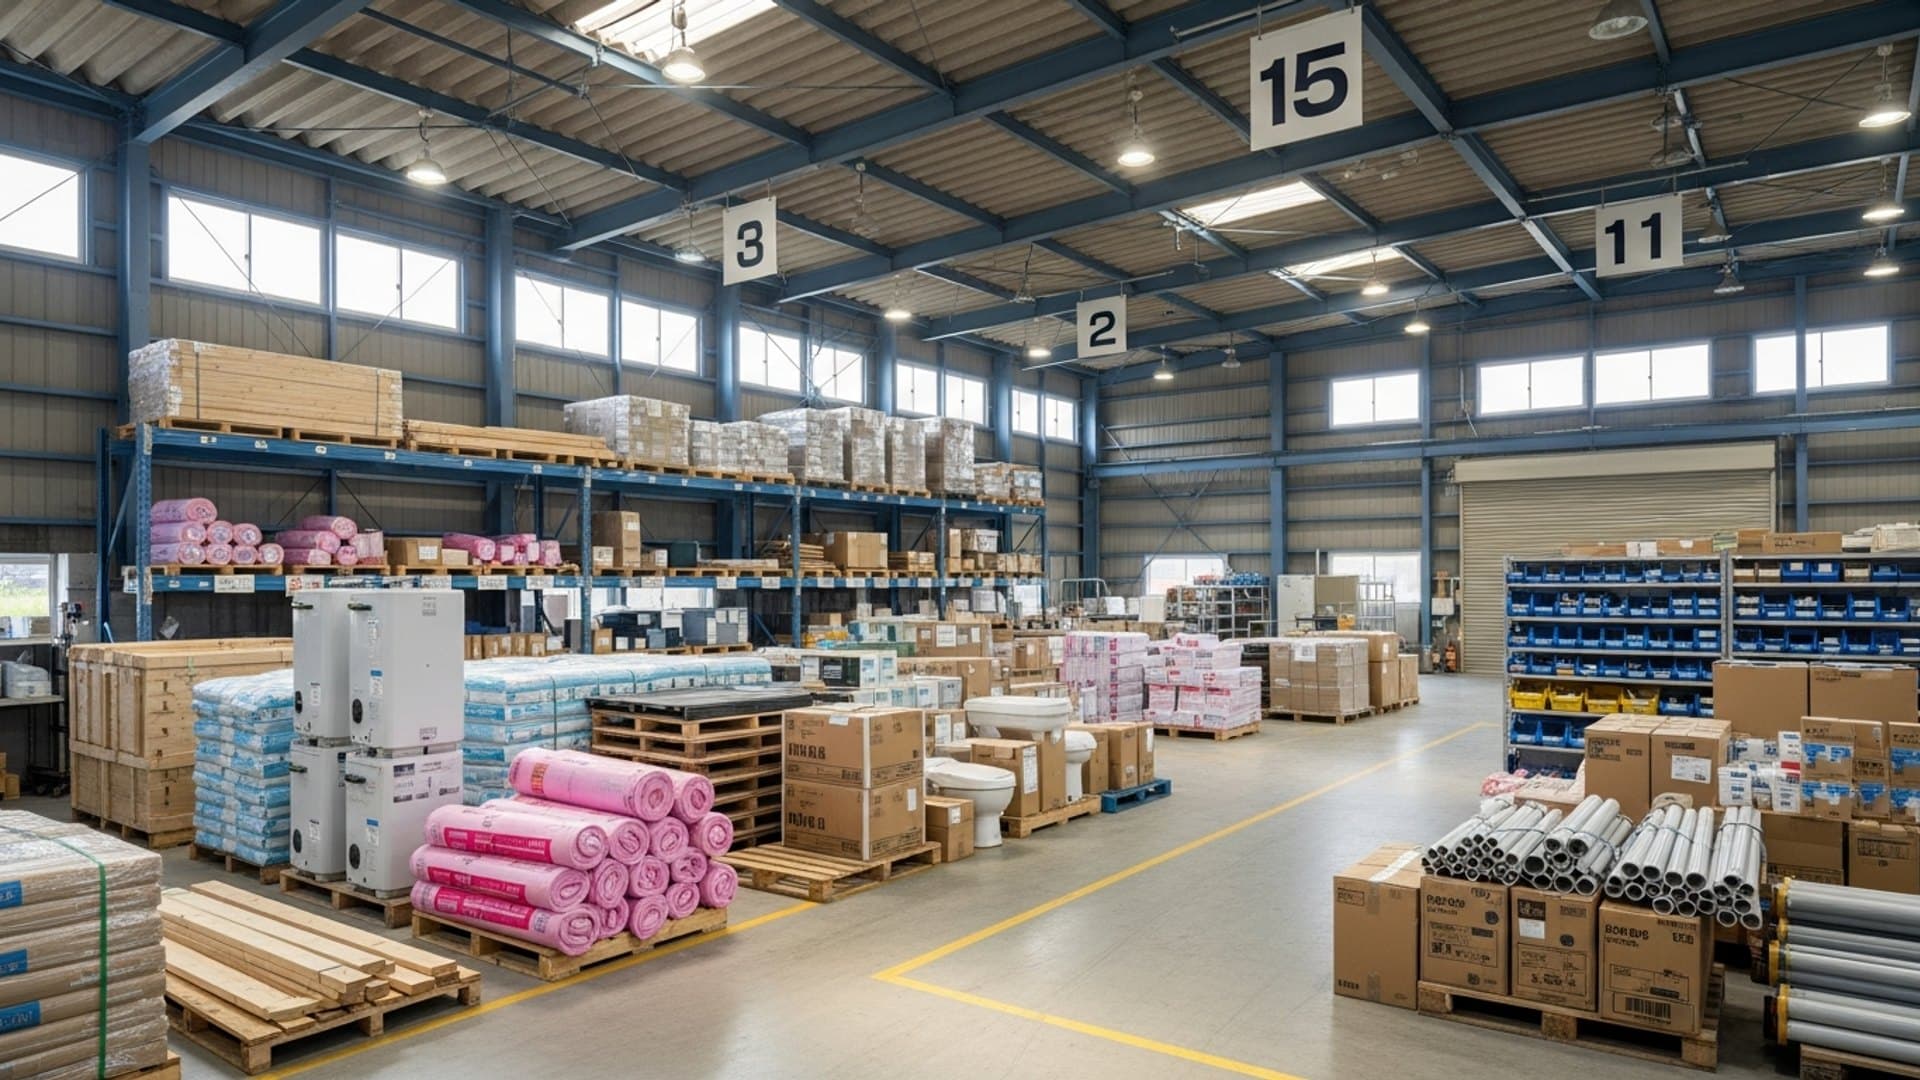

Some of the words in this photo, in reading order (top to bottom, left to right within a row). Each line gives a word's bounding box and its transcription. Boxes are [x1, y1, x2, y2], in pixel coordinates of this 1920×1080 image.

[1260, 41, 1348, 126] 15
[737, 220, 763, 267] 3
[1605, 212, 1662, 265] 11
[1089, 311, 1116, 347] 2
